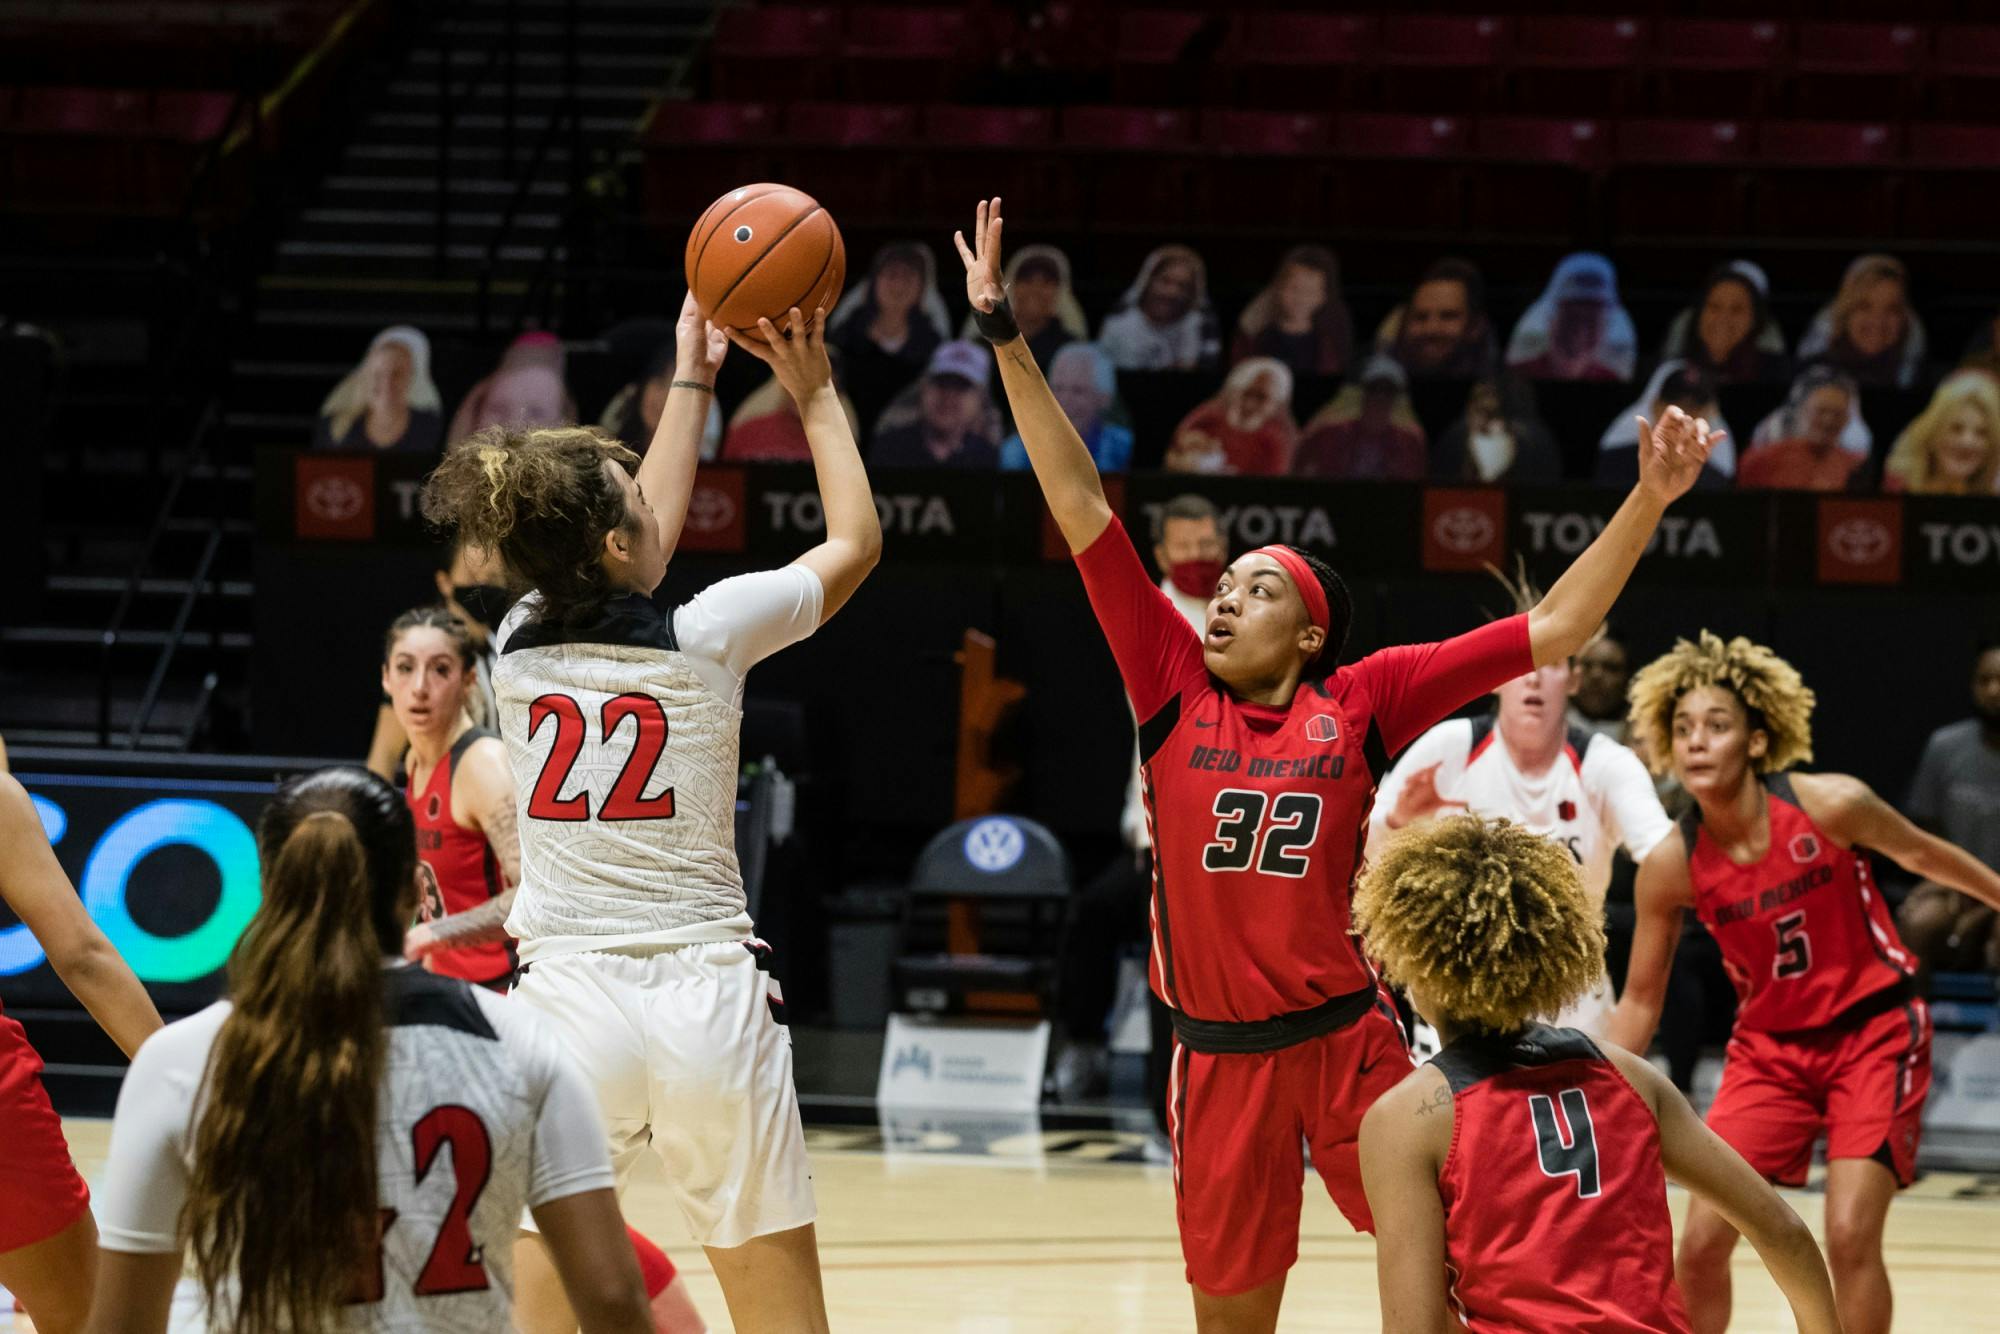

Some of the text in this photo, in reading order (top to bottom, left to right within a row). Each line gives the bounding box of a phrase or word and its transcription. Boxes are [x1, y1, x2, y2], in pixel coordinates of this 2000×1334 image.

[763, 491, 956, 536] TOTA
[1522, 512, 1723, 558] TOTA
[527, 692, 676, 822] 22
[1188, 744, 1346, 780] NEW MEXICO
[1202, 788, 1323, 879] 32
[1771, 909, 1813, 981] 5
[1528, 1087, 1602, 1199] 4
